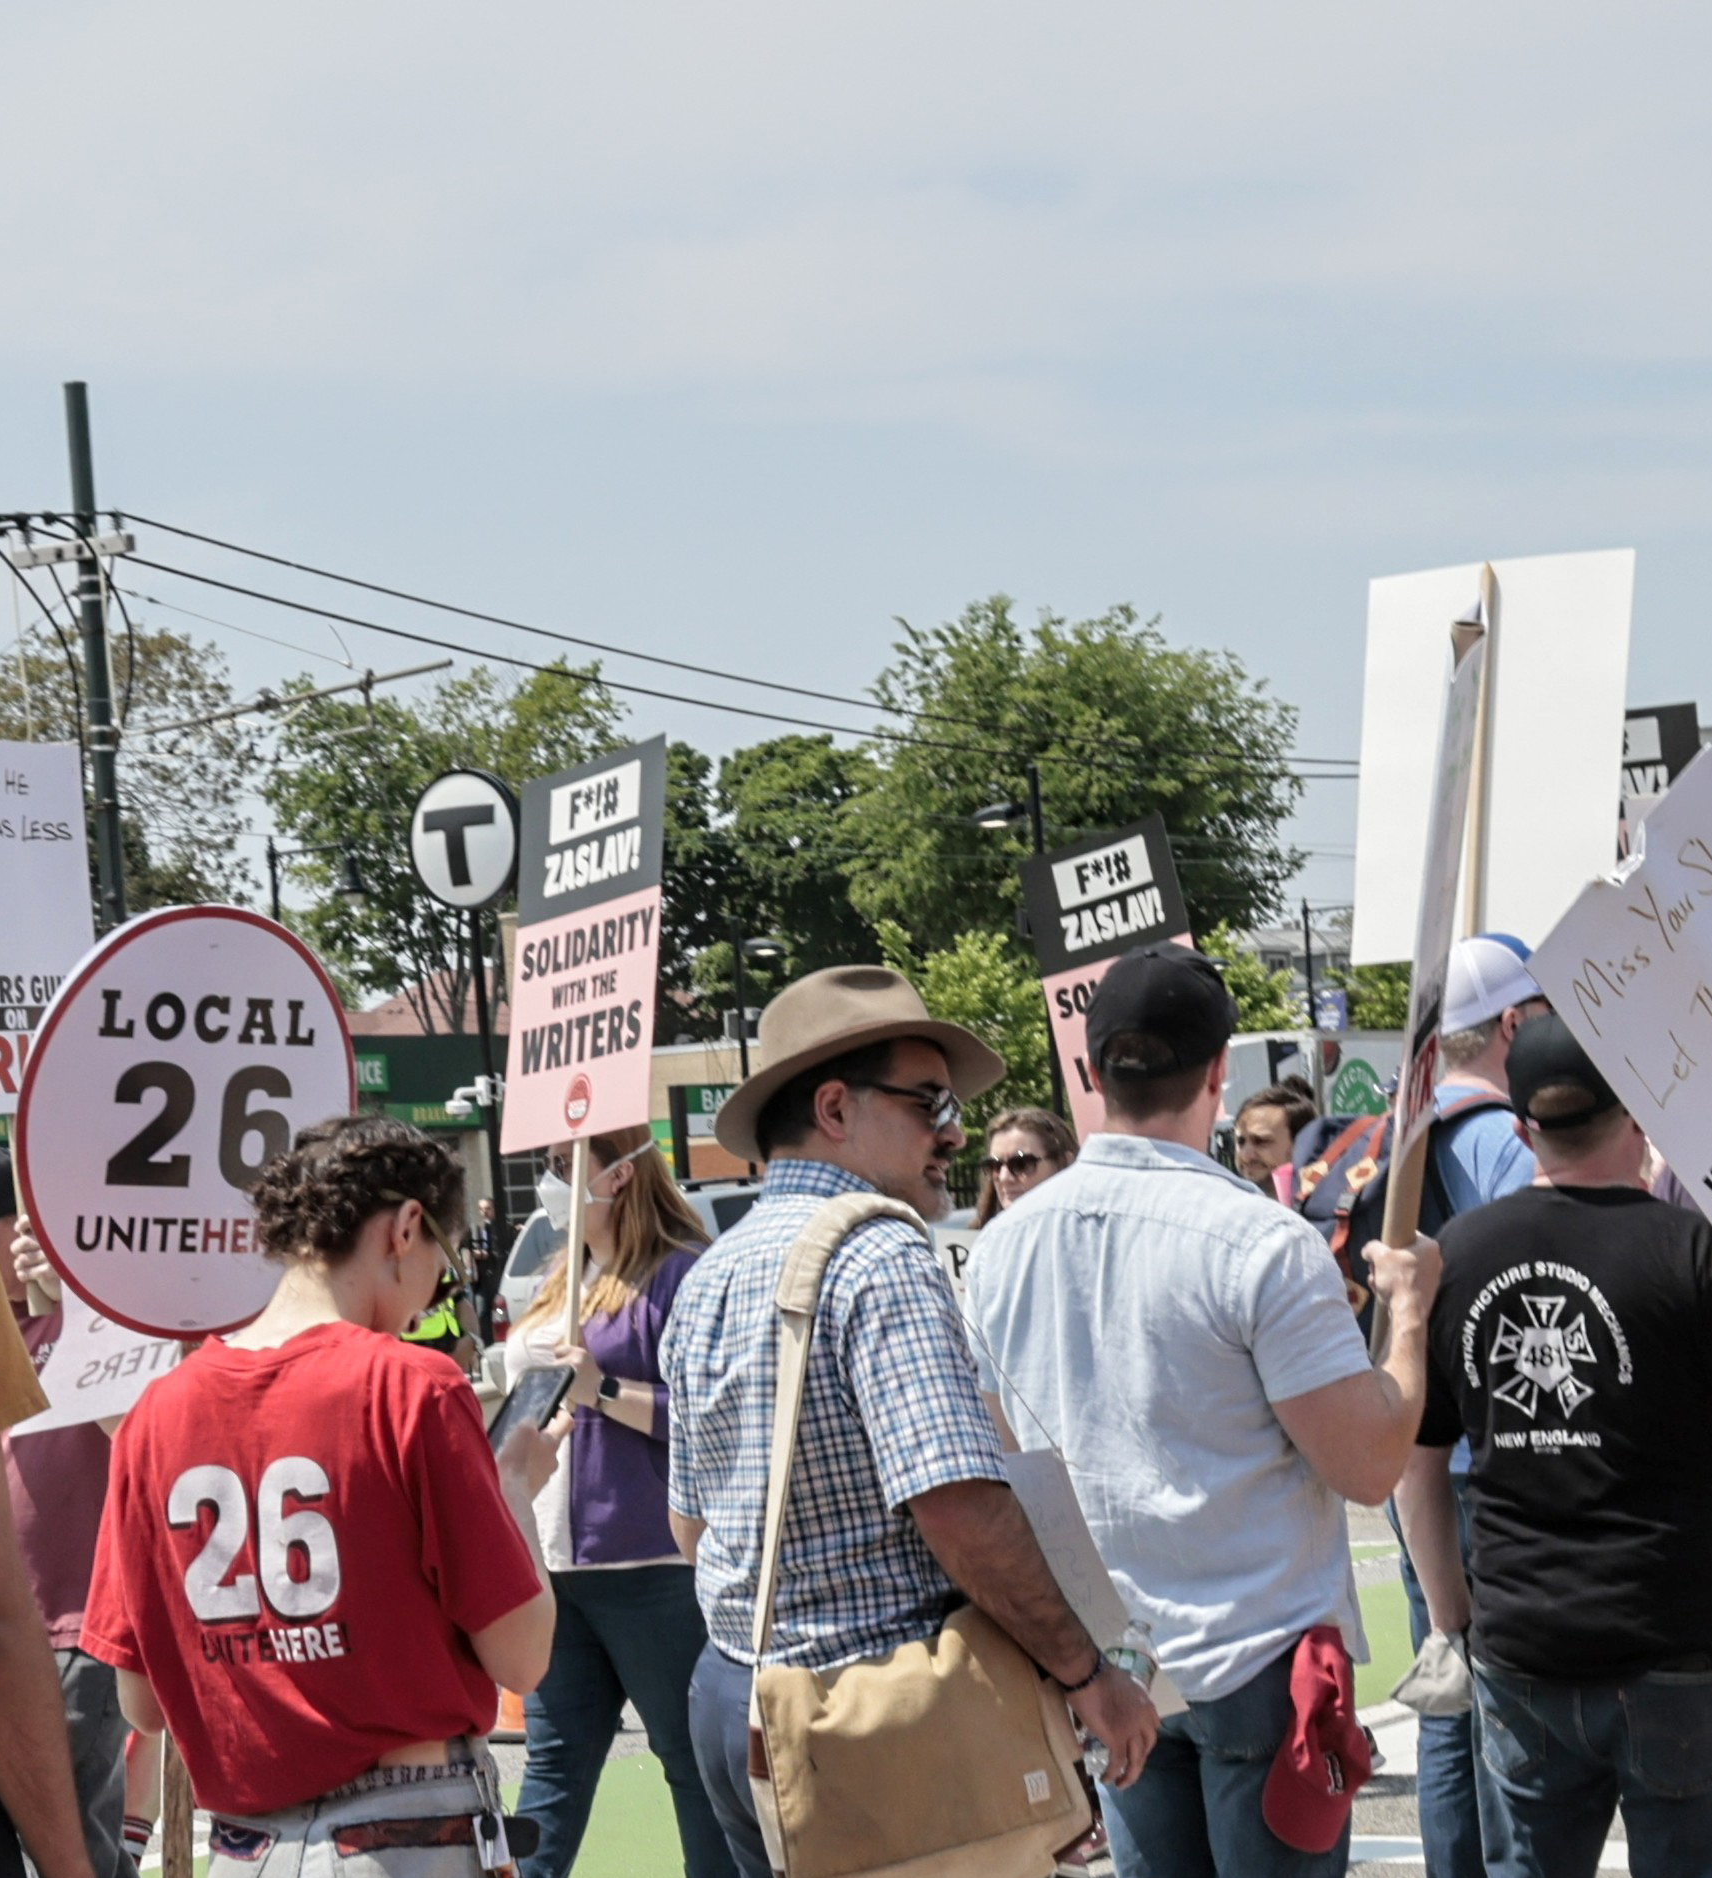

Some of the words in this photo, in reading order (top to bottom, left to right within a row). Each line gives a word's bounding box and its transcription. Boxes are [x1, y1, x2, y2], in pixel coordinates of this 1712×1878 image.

[4, 769, 30, 796] HE
[21, 815, 74, 842] LESS
[542, 824, 642, 899] ZASLAV!
[520, 905, 655, 983] SOLIDARITY
[1059, 886, 1166, 953] ZASLAV!
[551, 978, 587, 1010] WITH
[591, 968, 618, 1000] THE
[1572, 944, 1652, 1039] Miss
[1627, 885, 1696, 953] Your
[4, 1007, 28, 1029] ON
[98, 989, 315, 1047] LOCAL
[521, 998, 643, 1077] WRITERS
[1624, 1028, 1698, 1111] Let
[104, 1060, 293, 1189] 26
[1469, 1262, 1533, 1322] PICTURE
[1534, 1260, 1591, 1293] STUDIO
[1587, 1284, 1634, 1386] MECHANICS
[1523, 1343, 1566, 1370] 481
[1493, 1431, 1528, 1449] NEW
[1529, 1429, 1602, 1449] ENGLAND
[167, 1456, 341, 1625] 26
[199, 1620, 352, 1665] UNITEHERE!
